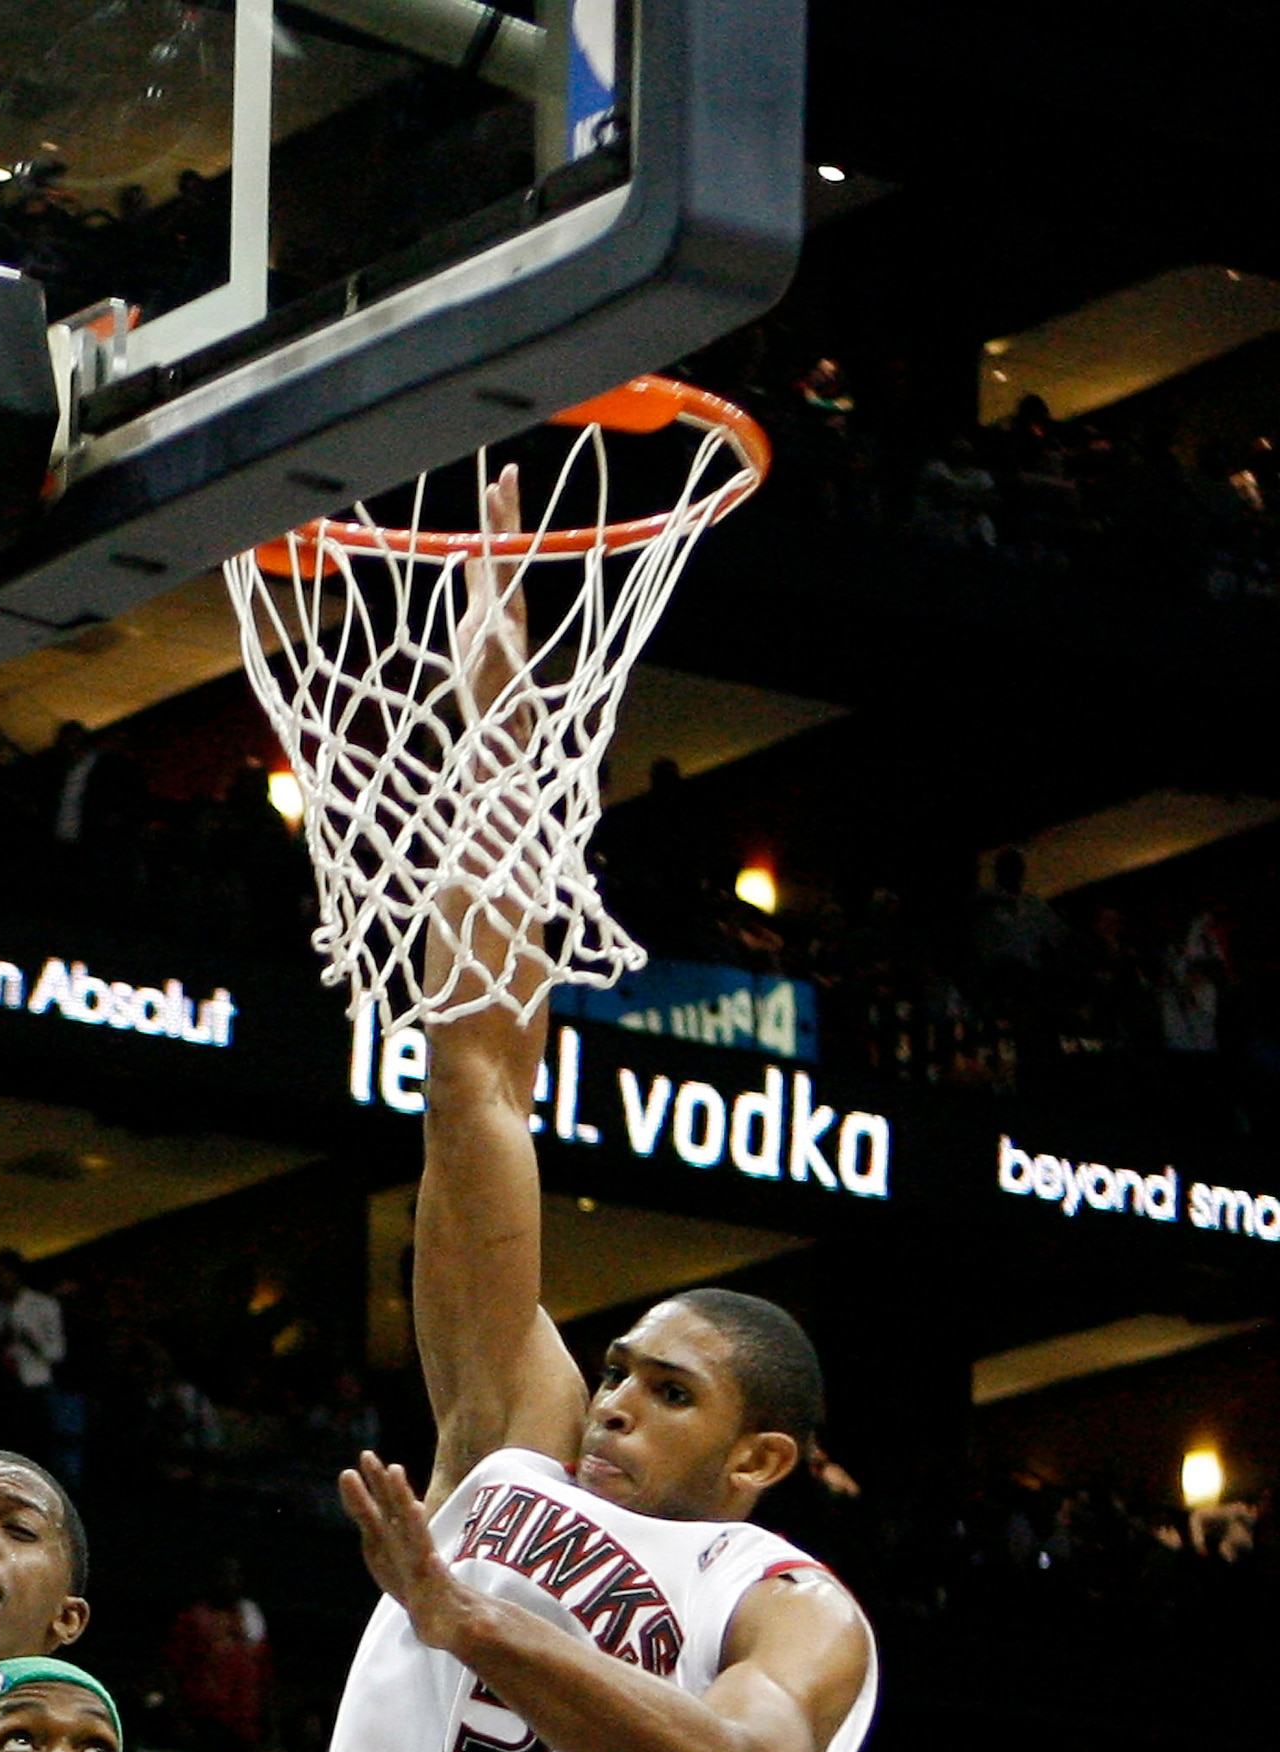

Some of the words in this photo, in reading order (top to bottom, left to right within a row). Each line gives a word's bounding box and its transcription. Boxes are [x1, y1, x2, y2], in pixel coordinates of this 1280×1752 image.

[27, 956, 238, 1048] Absolut
[618, 1063, 891, 1200] vodka
[996, 1133, 1182, 1222] beyond
